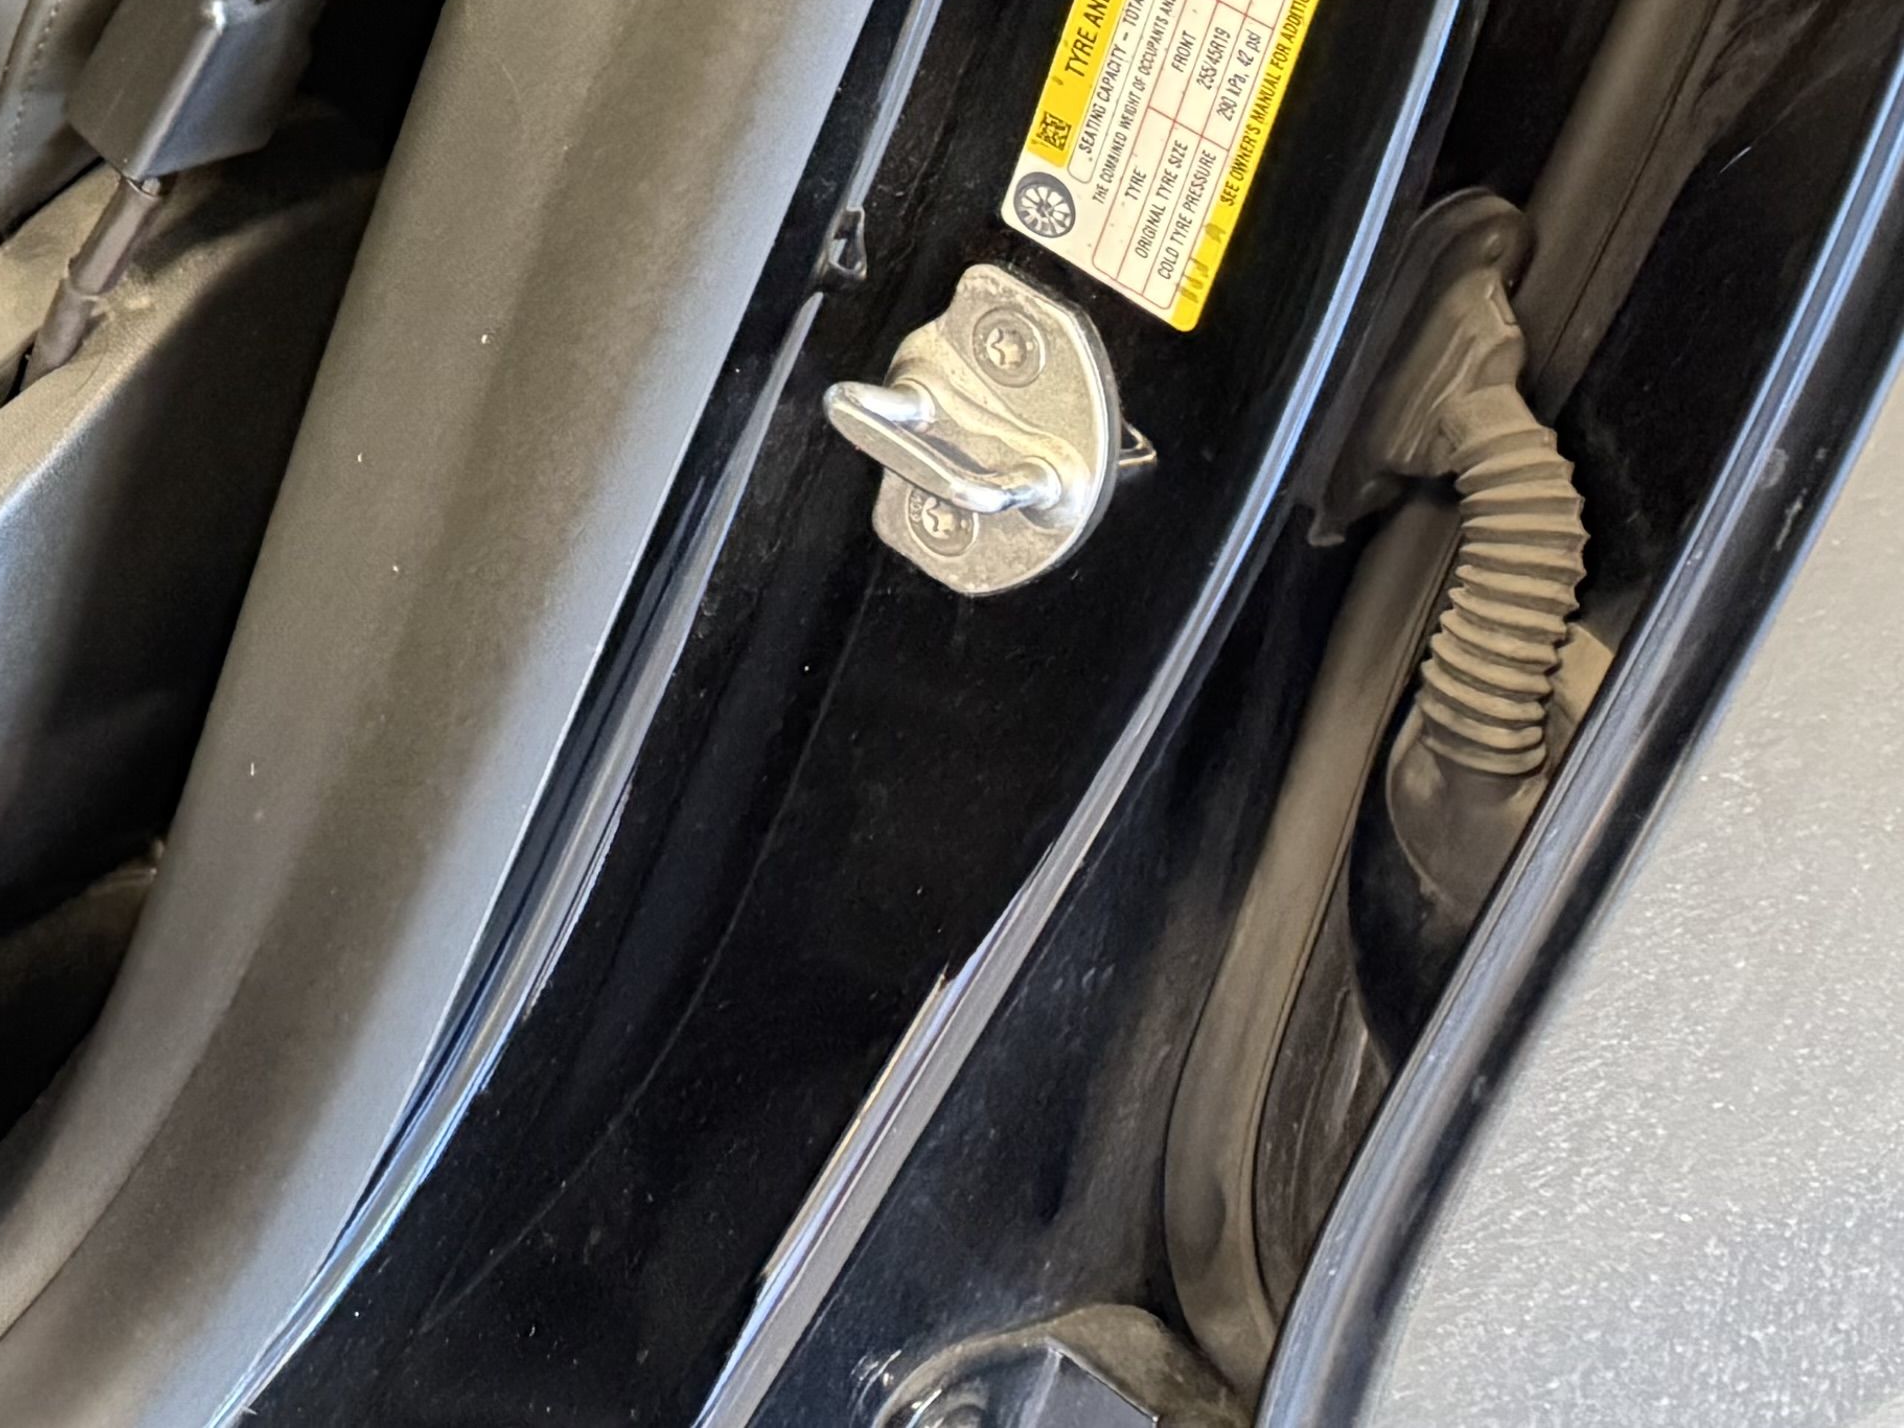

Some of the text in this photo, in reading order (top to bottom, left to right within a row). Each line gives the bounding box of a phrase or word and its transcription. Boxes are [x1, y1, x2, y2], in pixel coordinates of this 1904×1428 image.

[1063, 26, 1098, 78] TYRE
[1136, 14, 1169, 77] OCCUPANTS
[1170, 29, 1197, 73] FRONT
[1195, 25, 1232, 91] 255/45R19
[1268, 41, 1292, 71] FOR
[1077, 101, 1107, 155] SEATING
[1095, 42, 1127, 103] CAPACITY
[1118, 89, 1142, 131] WEIGHT
[1131, 74, 1146, 93] OF
[1215, 94, 1238, 122] 290
[1235, 48, 1255, 68] 42
[1249, 71, 1282, 125] MANUAL
[1098, 130, 1128, 184] COMBINED
[1228, 123, 1262, 182] OWNER'S
[1090, 182, 1110, 205] THE
[1123, 167, 1148, 201] TYRE
[1133, 138, 1189, 260] ORIGINAL TYRE SIZE
[1219, 179, 1241, 207] SEE
[1156, 148, 1217, 281] COLD TYRE PRESSURE
